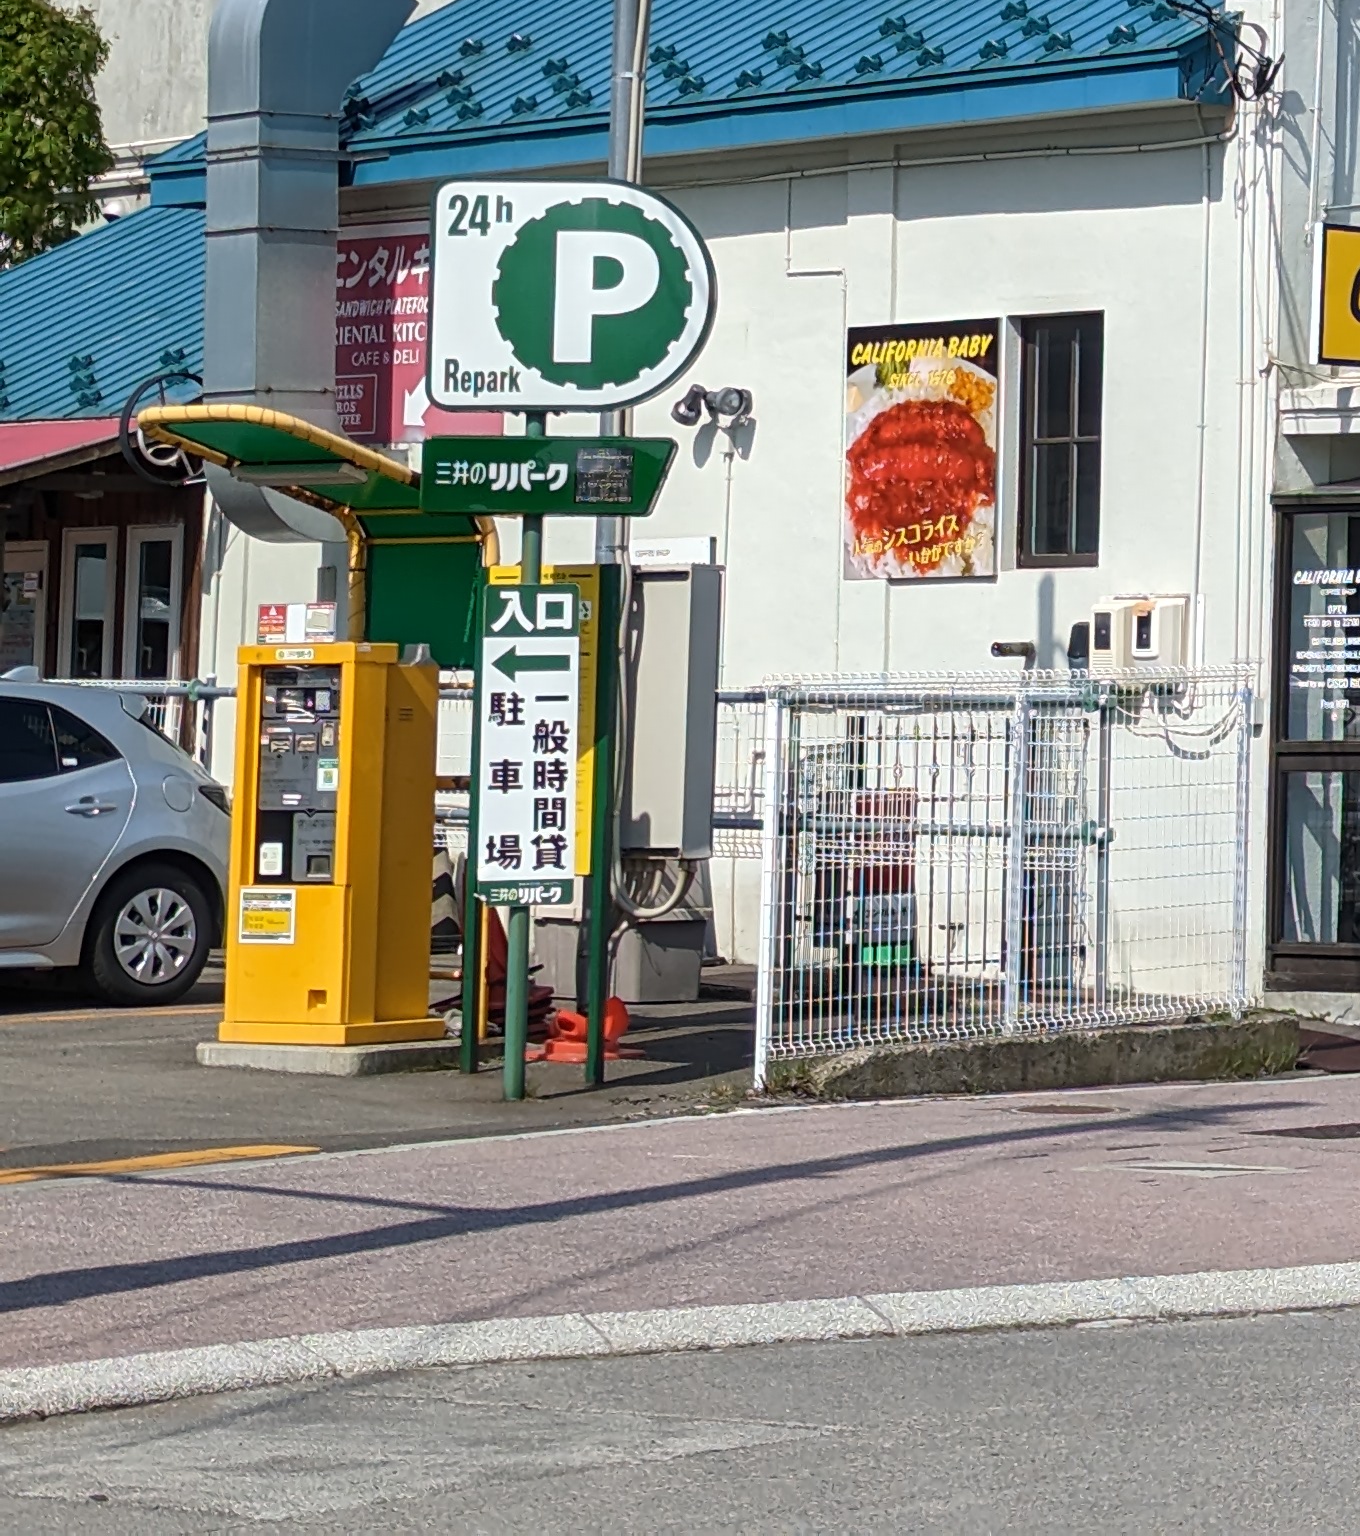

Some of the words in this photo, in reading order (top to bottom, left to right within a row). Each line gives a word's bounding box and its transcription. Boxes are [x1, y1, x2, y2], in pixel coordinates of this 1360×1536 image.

[553, 230, 660, 363] P
[335, 324, 386, 345] IENTAL
[393, 321, 428, 342] KITC
[851, 337, 944, 365] CALIFORNIA
[947, 333, 993, 359] BABY
[352, 351, 380, 366] CAFE
[393, 349, 420, 365] DELI
[444, 358, 521, 398] Repark
[435, 459, 568, 492] 三井のリパーク
[1293, 570, 1354, 584] CALIFORNIA
[490, 590, 573, 633] 入口
[485, 692, 526, 870] 駐車場
[531, 695, 569, 872] 一般時間貸
